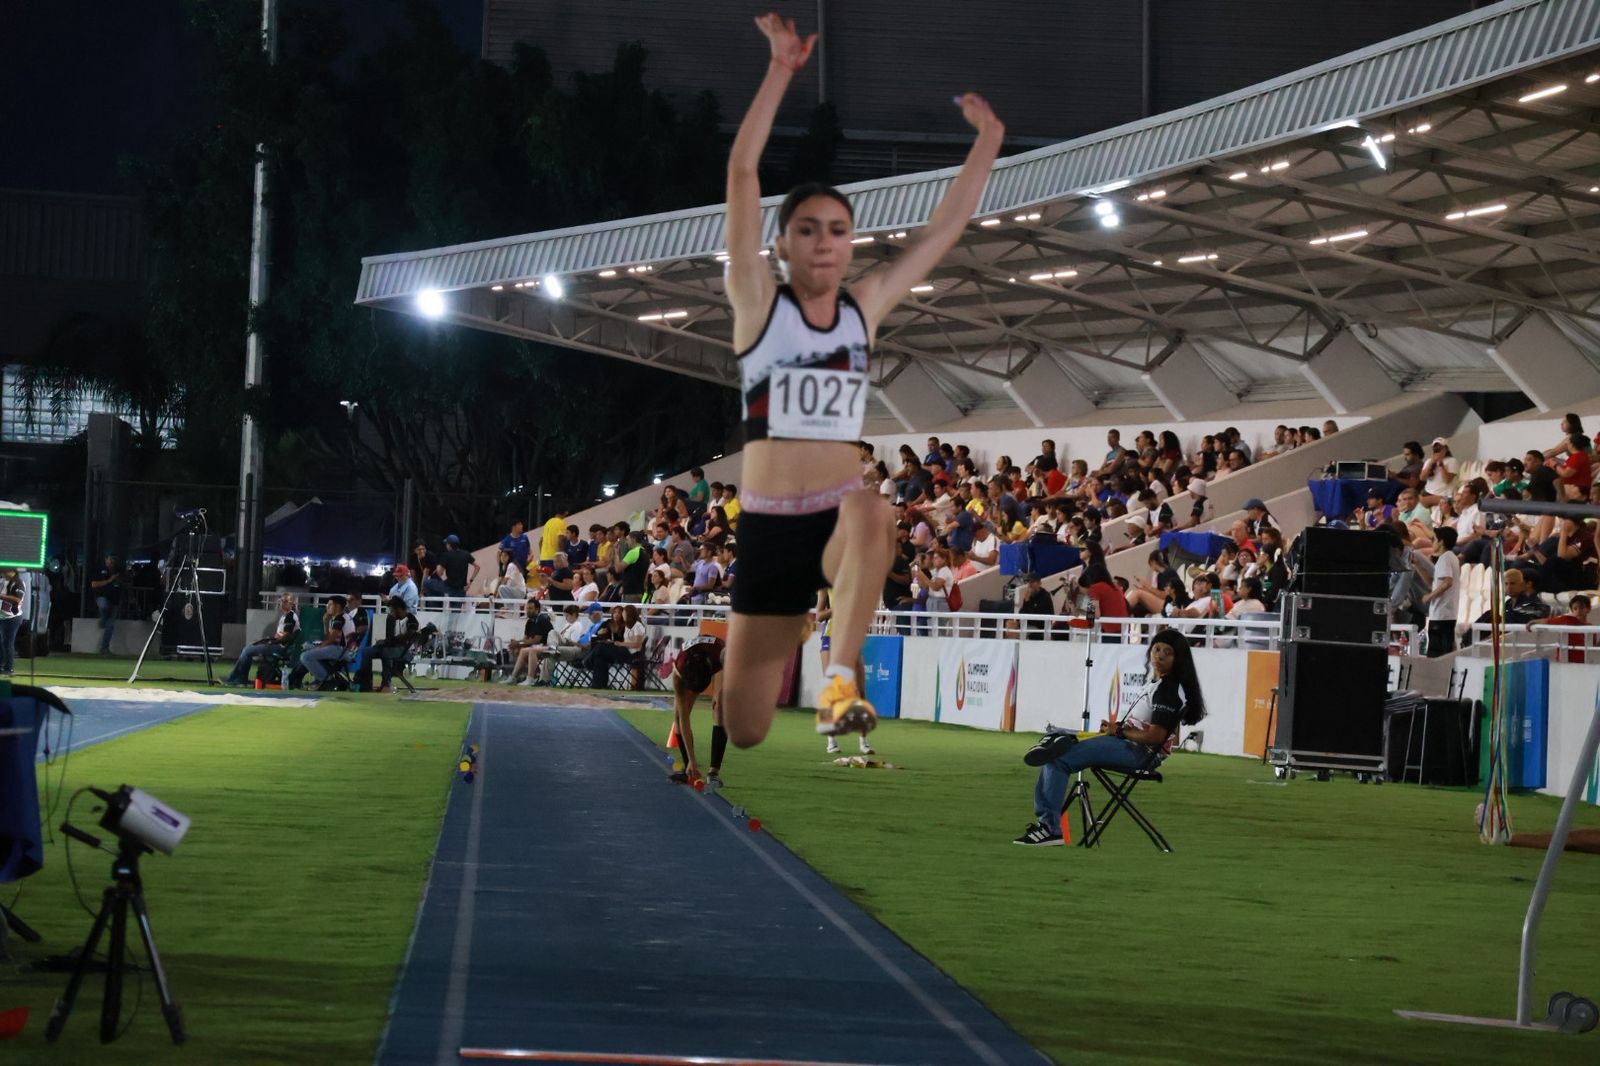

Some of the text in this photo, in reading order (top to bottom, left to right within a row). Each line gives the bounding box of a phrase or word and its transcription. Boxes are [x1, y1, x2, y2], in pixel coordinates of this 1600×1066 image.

[776, 373, 862, 417] 1027
[745, 495, 794, 511] NIKE
[966, 681, 989, 694] NACIONAL
